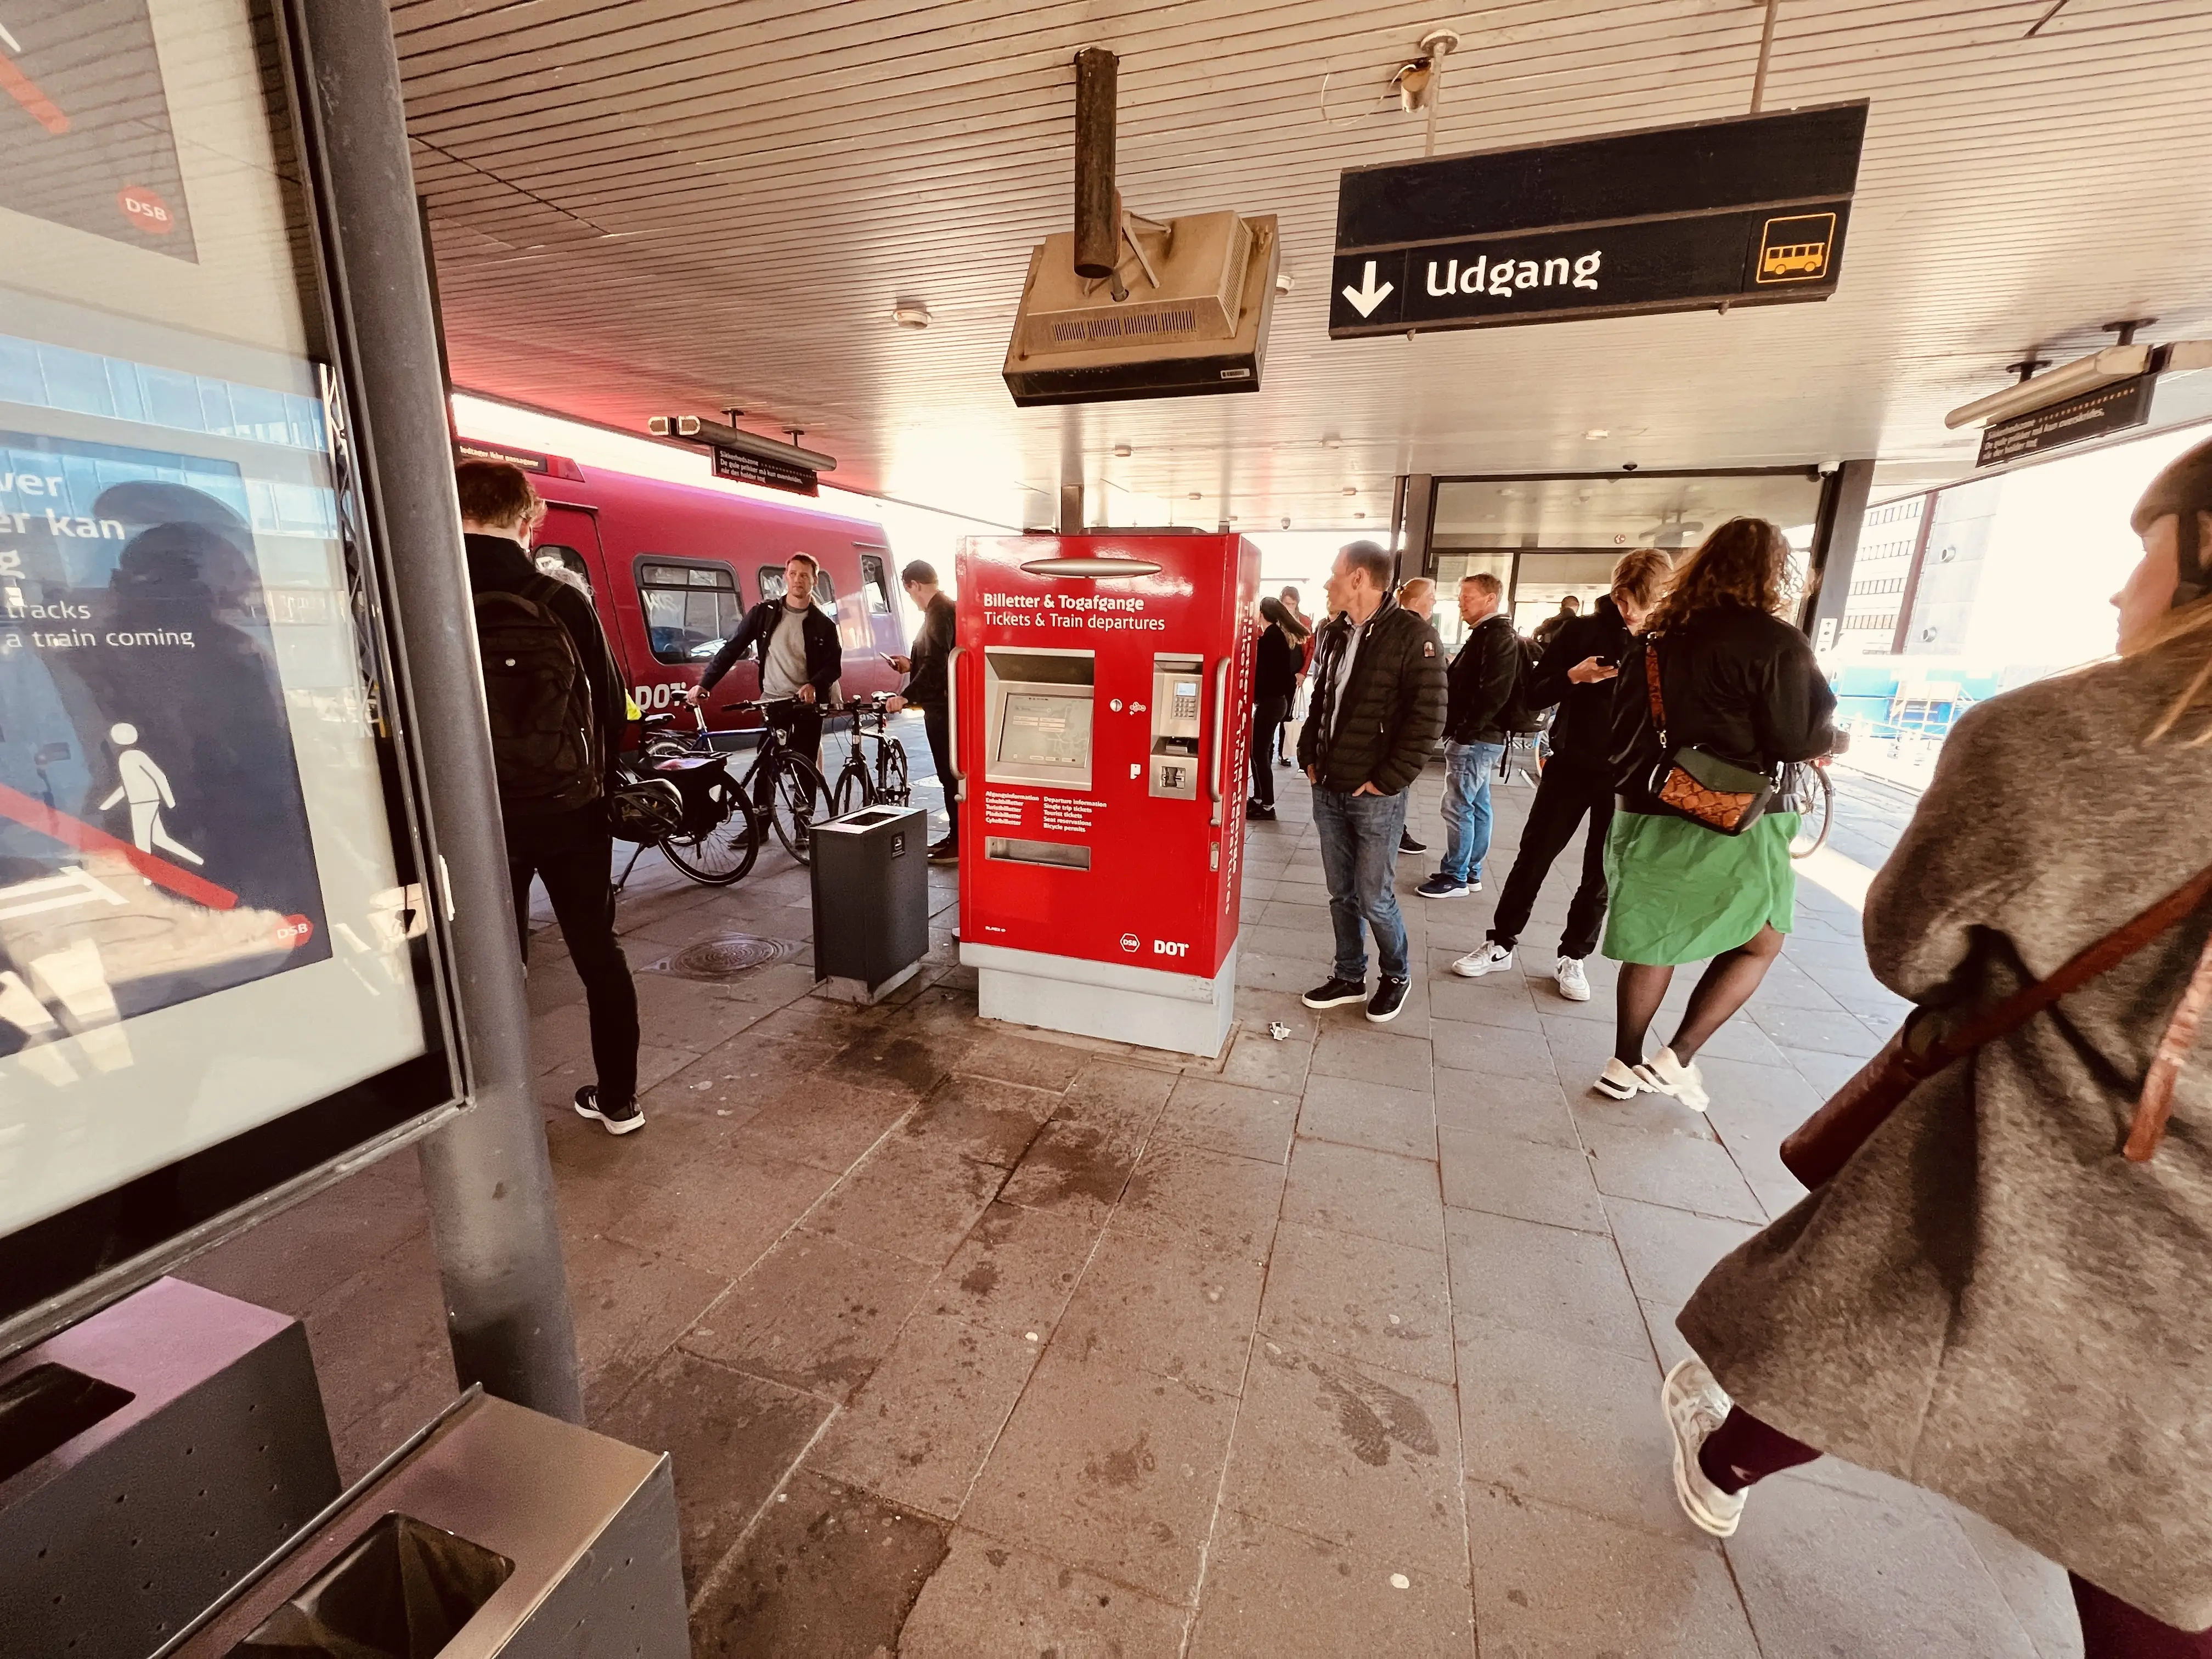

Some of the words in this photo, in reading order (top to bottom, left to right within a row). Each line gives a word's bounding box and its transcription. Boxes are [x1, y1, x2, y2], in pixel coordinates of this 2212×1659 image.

[125, 197, 168, 221] DSB
[1426, 250, 1602, 298] Udgang
[46, 507, 126, 540] kan
[984, 592, 1041, 608] Billetter
[1043, 594, 1055, 609] &
[1058, 594, 1144, 613] Togafgange
[984, 611, 1031, 627] Tickets
[1035, 612, 1046, 627] &
[1049, 613, 1083, 628] Train
[1087, 613, 1165, 632] departures
[5, 633, 23, 648] a
[32, 628, 97, 648] train
[105, 628, 196, 648] coming
[1043, 796, 1073, 804] Departure
[1073, 799, 1107, 808] information
[1057, 819, 1092, 827] reservations
[276, 923, 308, 939] DSB
[1154, 939, 1189, 957] DOT
